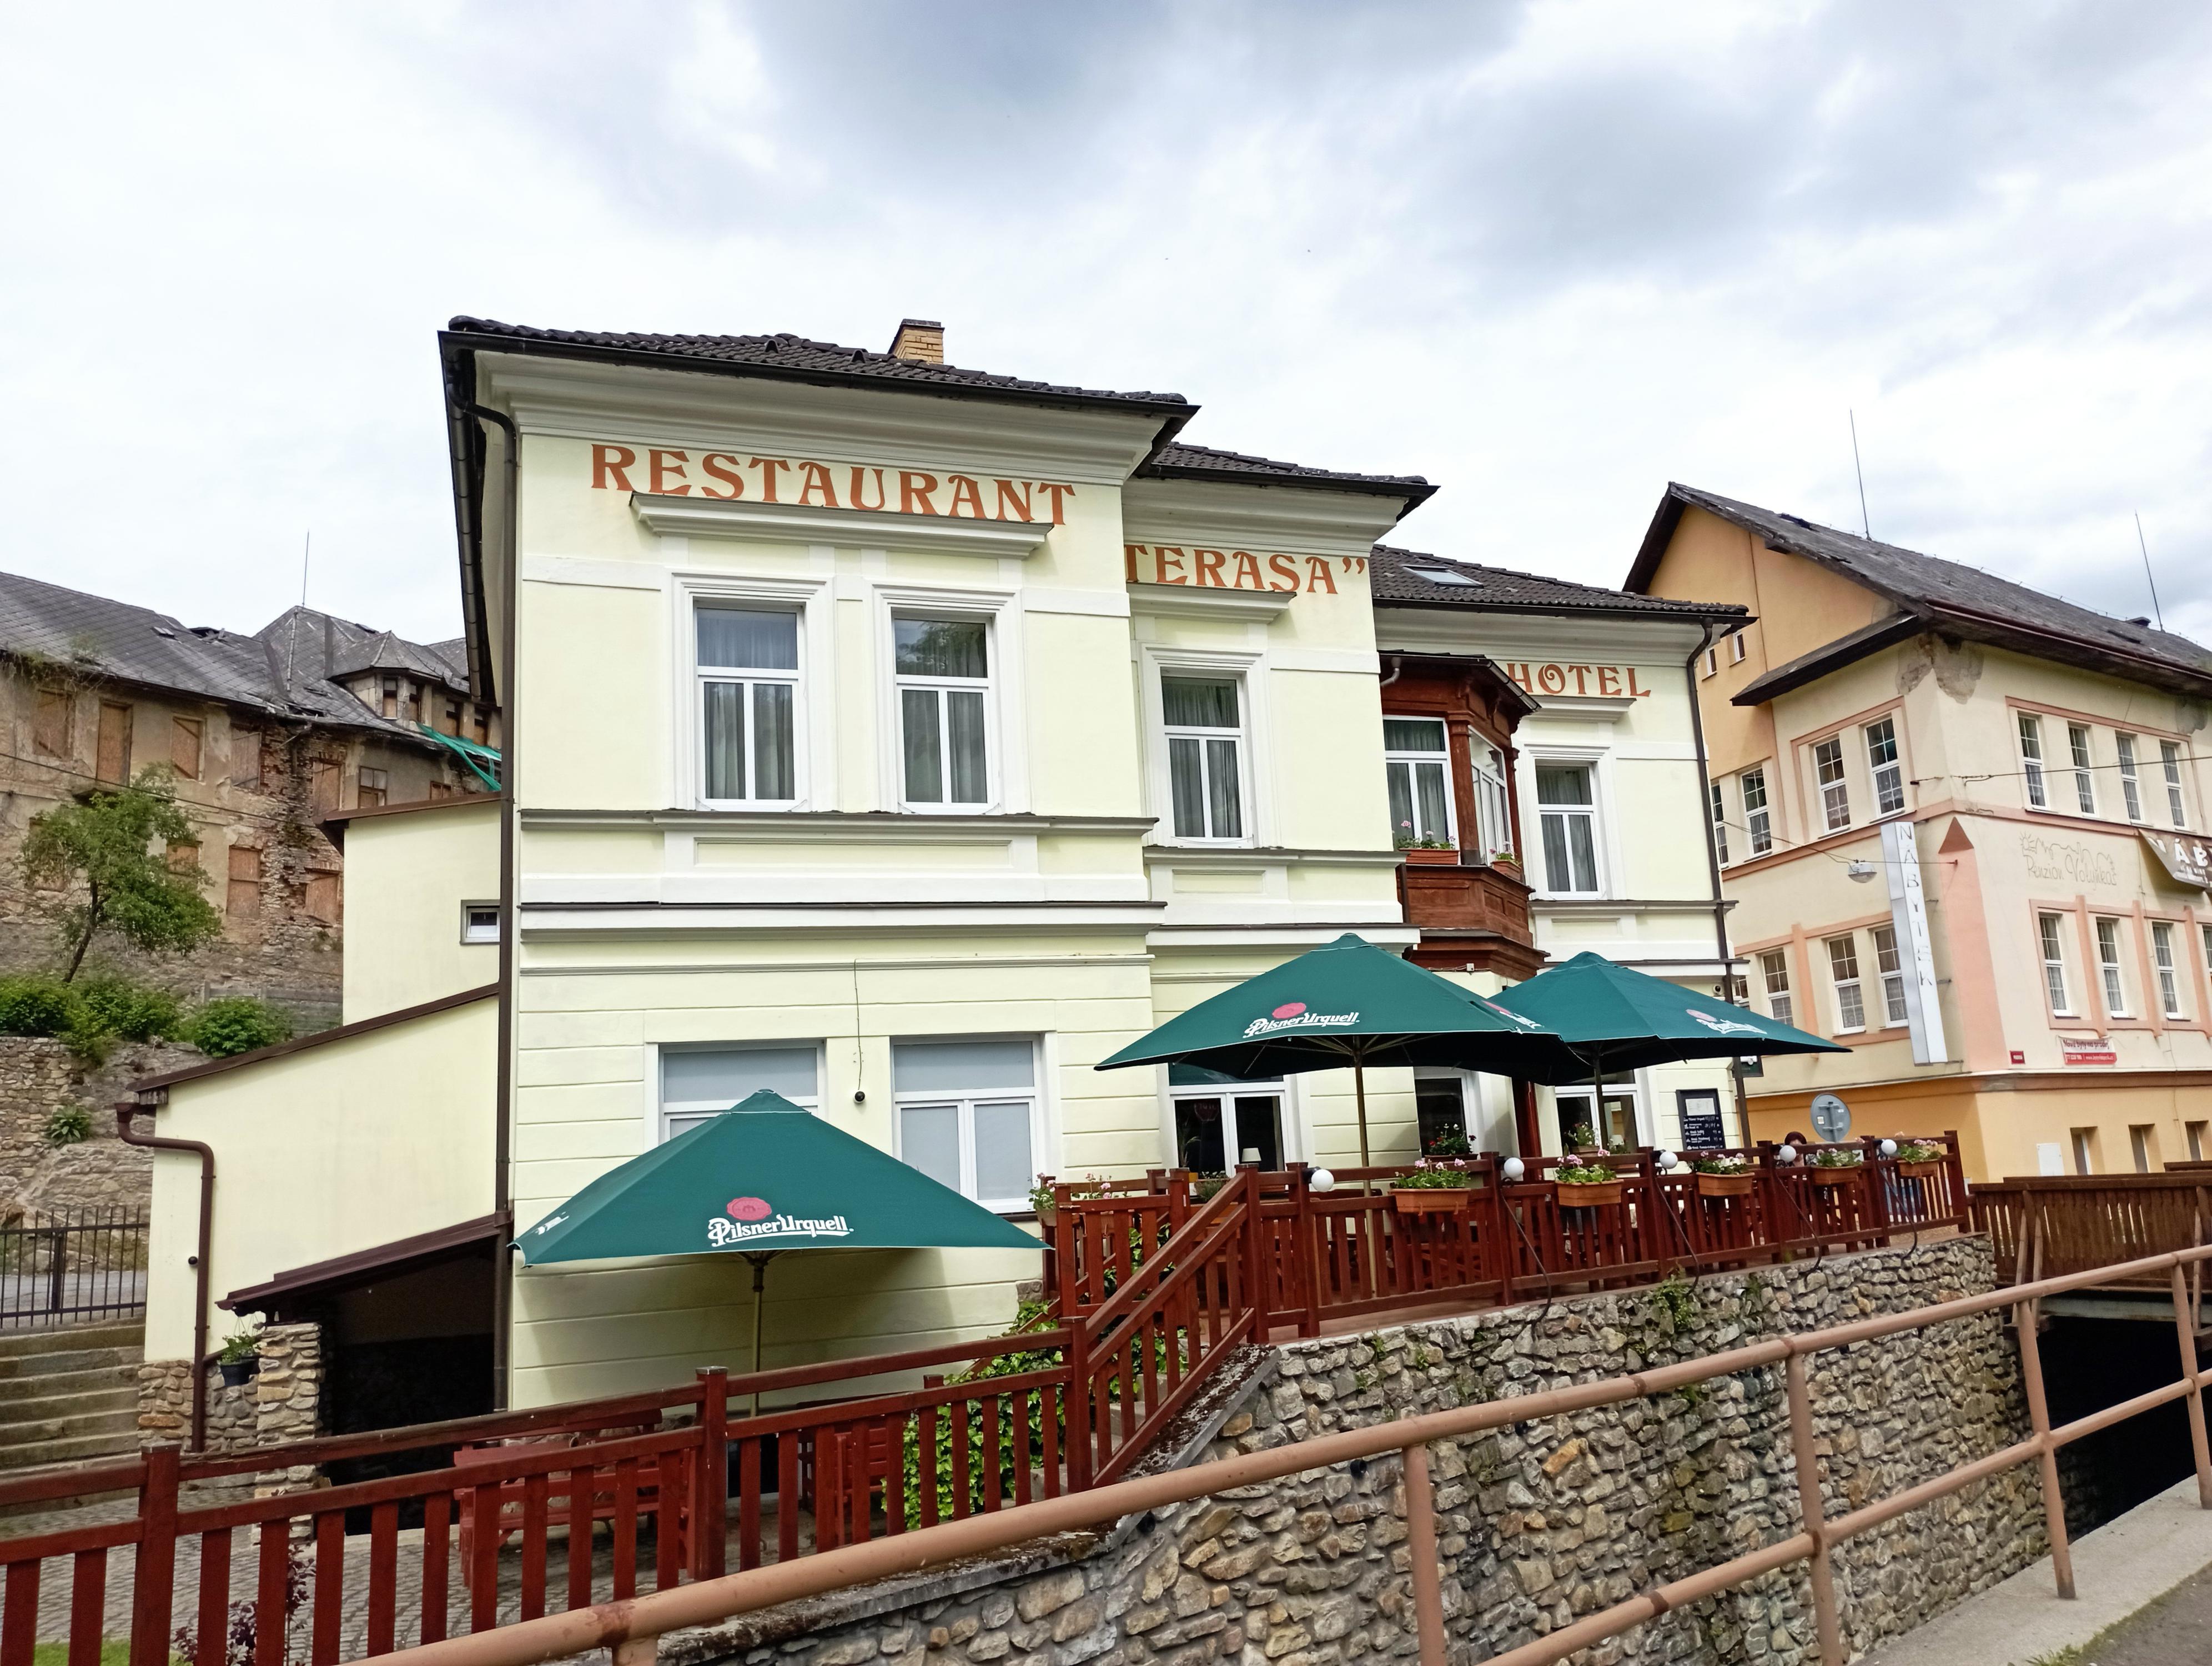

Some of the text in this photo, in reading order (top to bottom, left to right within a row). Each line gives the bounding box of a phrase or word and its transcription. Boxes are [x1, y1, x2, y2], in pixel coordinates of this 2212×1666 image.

[591, 444, 1075, 525] RESTAURANT
[1506, 663, 1651, 697] HOTEL
[1243, 1017, 1303, 1038] Pilsner
[707, 1217, 780, 1247] Pilsner
